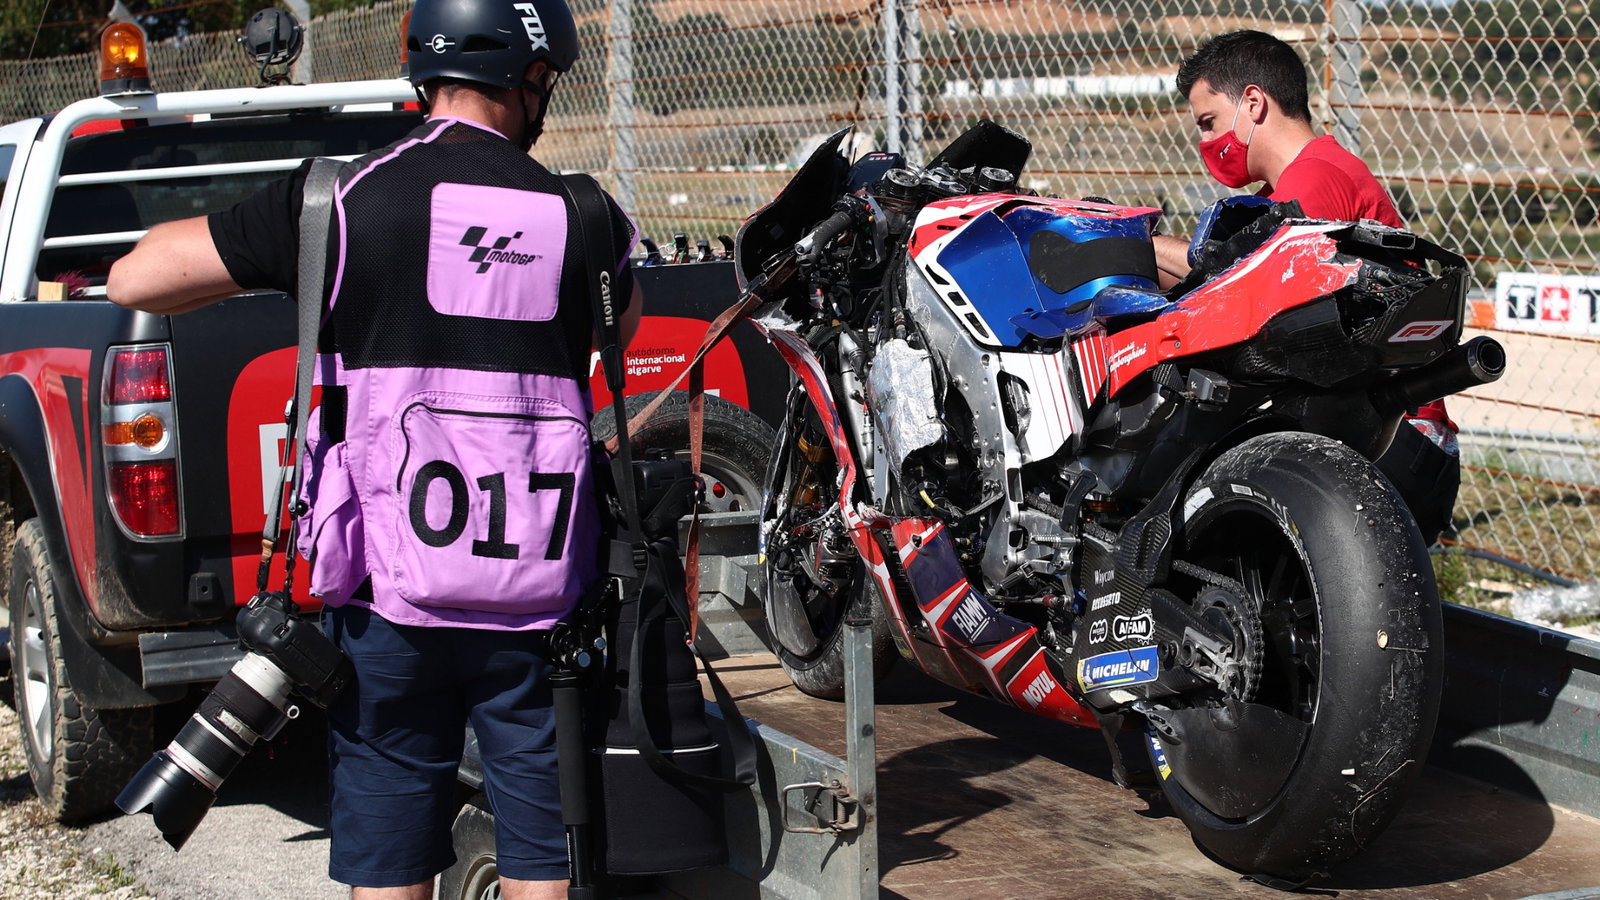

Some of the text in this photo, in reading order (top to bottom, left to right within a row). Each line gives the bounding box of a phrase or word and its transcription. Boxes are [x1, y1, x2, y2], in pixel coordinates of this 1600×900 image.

[513, 2, 550, 51] FOX
[600, 270, 614, 327] Canon
[626, 353, 686, 366] internacional
[627, 365, 662, 376] algarve
[409, 459, 576, 560] 017
[951, 592, 988, 639] FIAMM
[1021, 670, 1056, 709] MOTUL
[1092, 659, 1150, 680] MICHELIN
